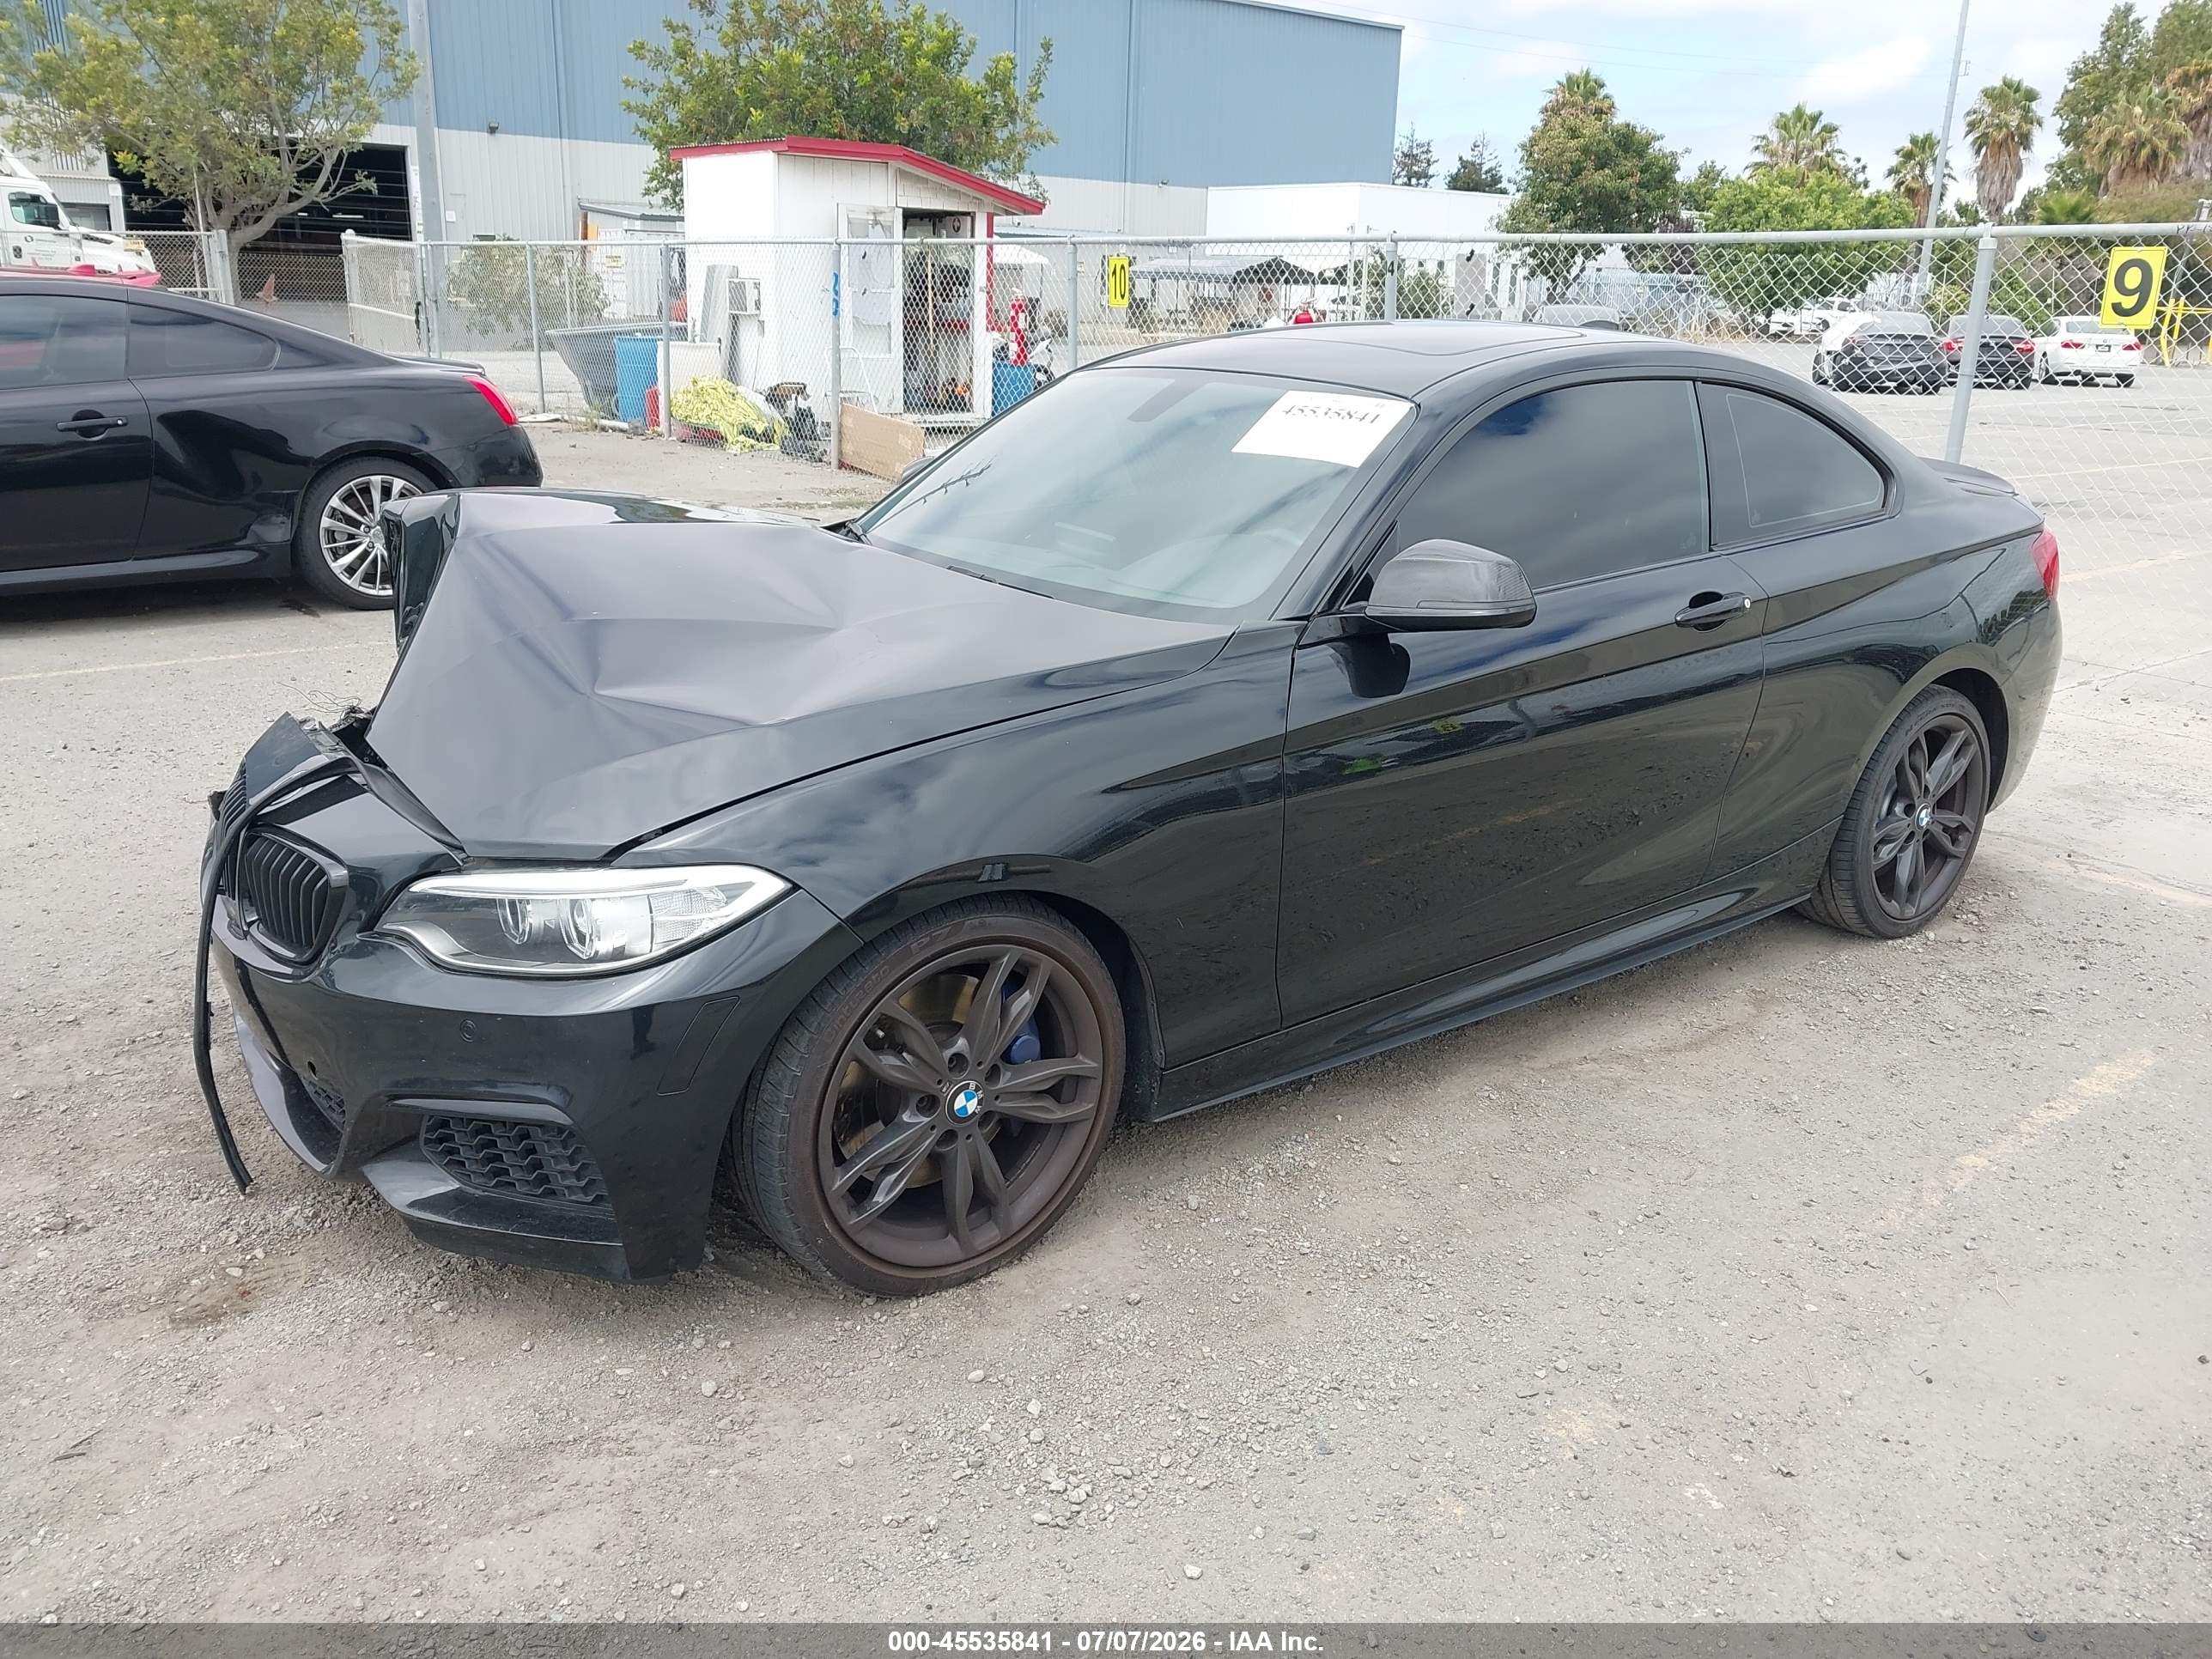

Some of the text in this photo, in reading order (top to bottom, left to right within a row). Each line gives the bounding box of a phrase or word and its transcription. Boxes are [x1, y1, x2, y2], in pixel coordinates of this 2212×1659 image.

[1111, 263, 1127, 301] 10
[1387, 260, 1395, 276] 4
[2111, 258, 2154, 317] 9
[969, 1081, 985, 1115] BMW
